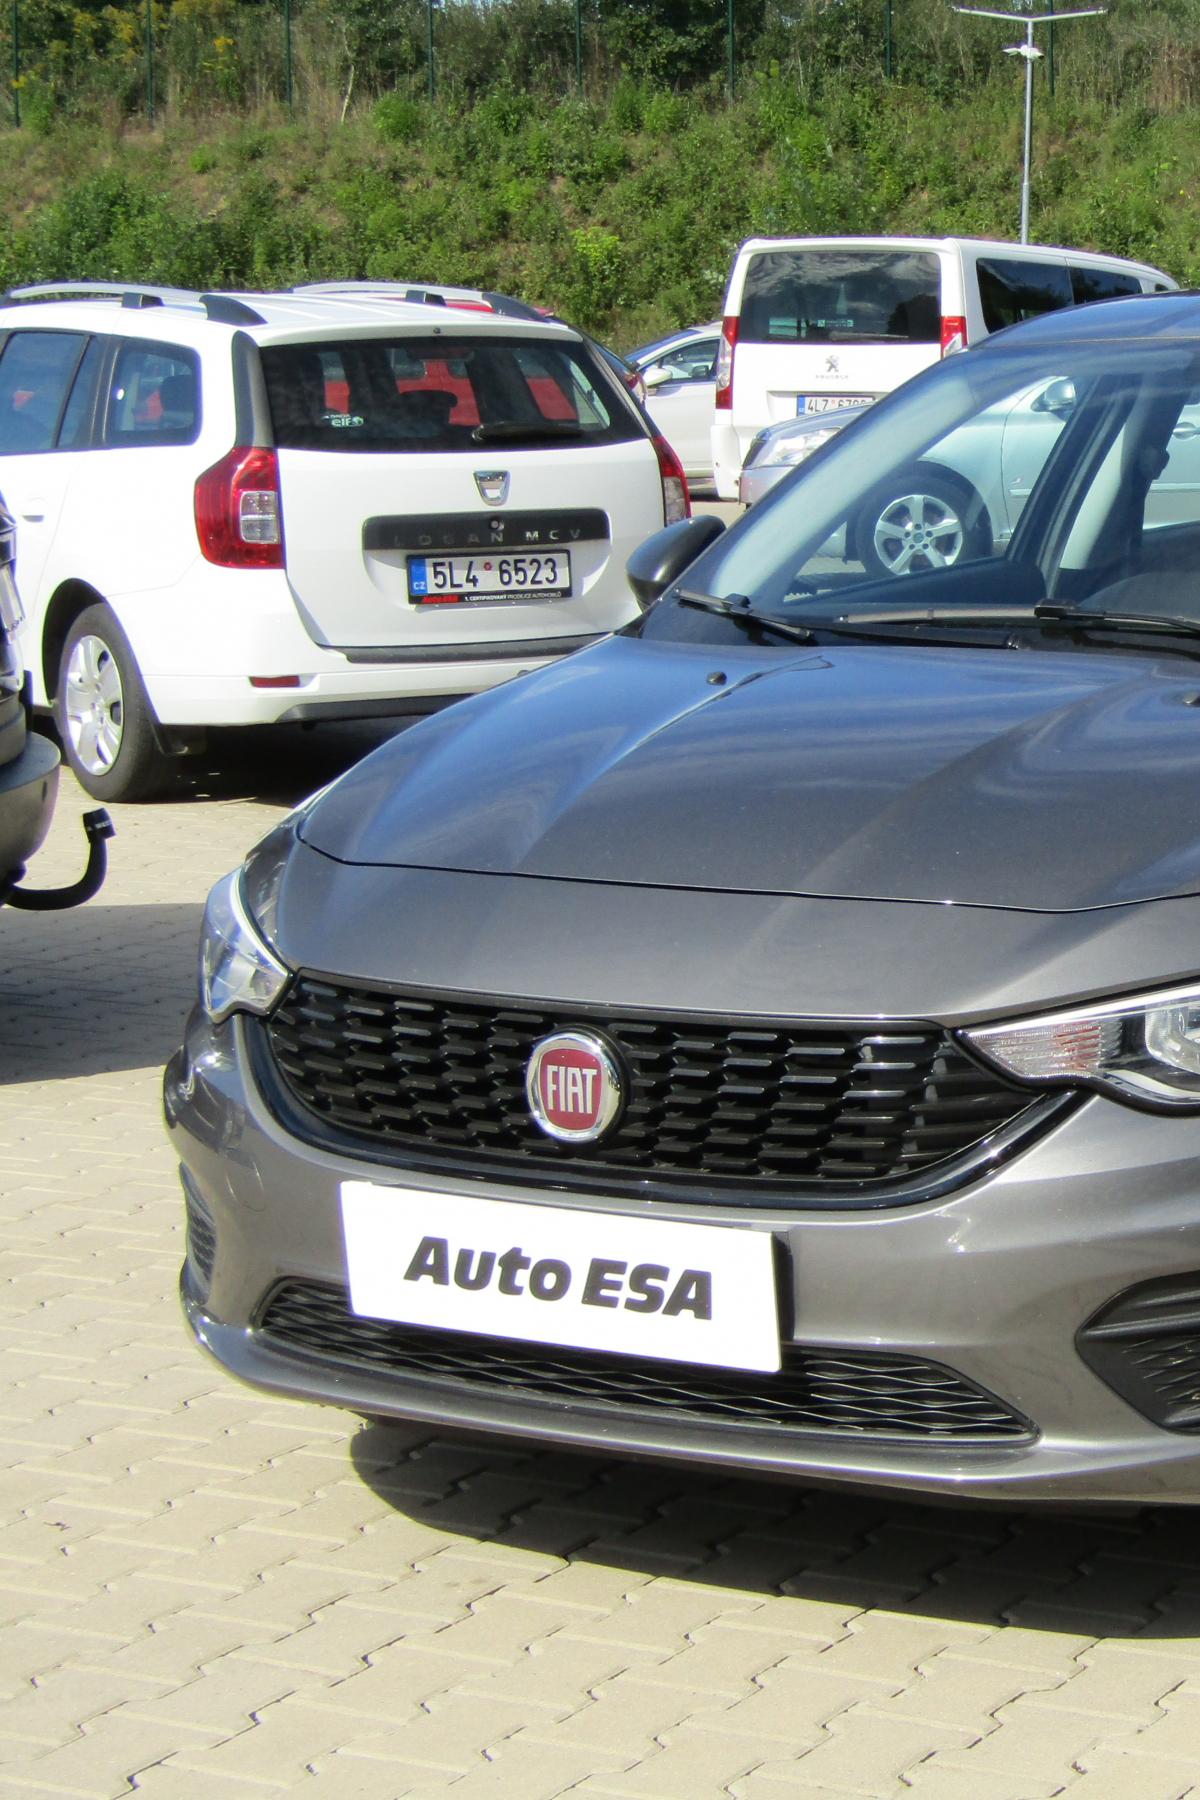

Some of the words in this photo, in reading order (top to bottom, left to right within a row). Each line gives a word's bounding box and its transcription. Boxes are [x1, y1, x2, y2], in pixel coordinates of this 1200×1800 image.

[394, 532, 504, 547] LOGAN
[525, 528, 581, 542] MCV
[413, 581, 426, 591] CZ
[432, 560, 479, 589] 5L4
[498, 557, 558, 586] 6523
[547, 1063, 598, 1114] FIAT
[404, 1236, 571, 1301] Auto
[581, 1257, 712, 1320] ESA
